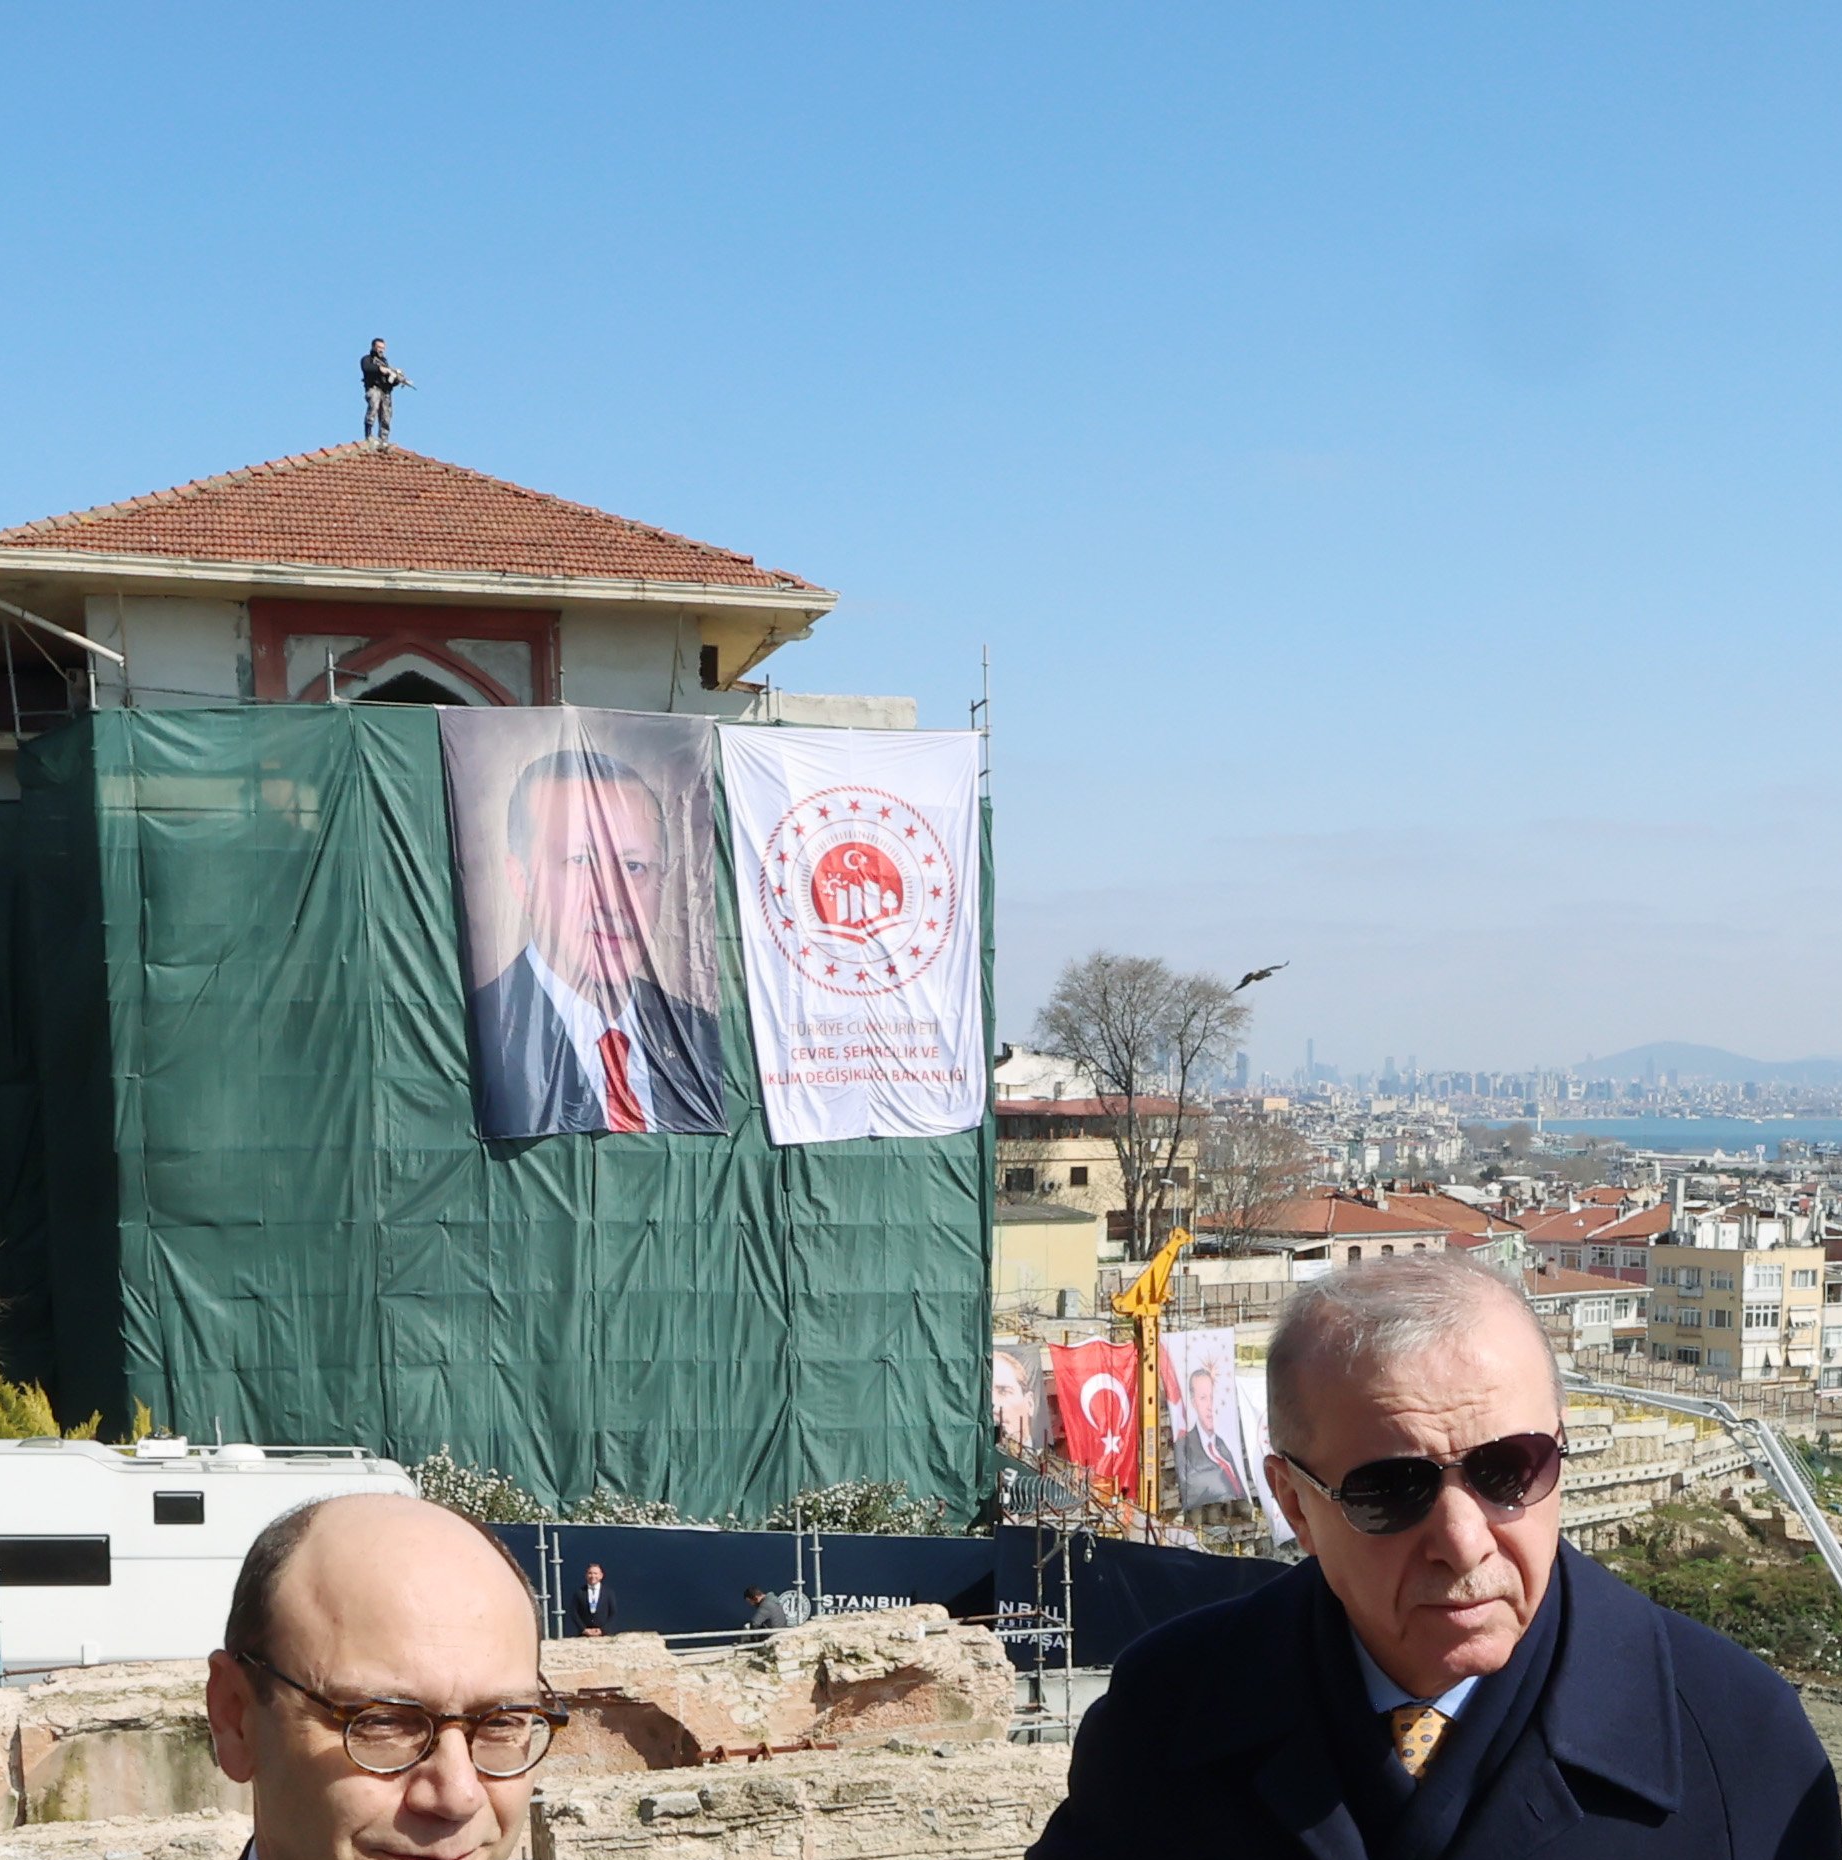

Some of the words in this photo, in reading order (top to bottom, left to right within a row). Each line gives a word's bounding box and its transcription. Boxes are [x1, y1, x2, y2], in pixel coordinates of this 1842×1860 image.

[790, 1021, 843, 1037] TÜRKİYE
[791, 1047, 839, 1062] ÇEVRE,
[922, 1046, 939, 1058] VE
[764, 1071, 801, 1085] İKLİM
